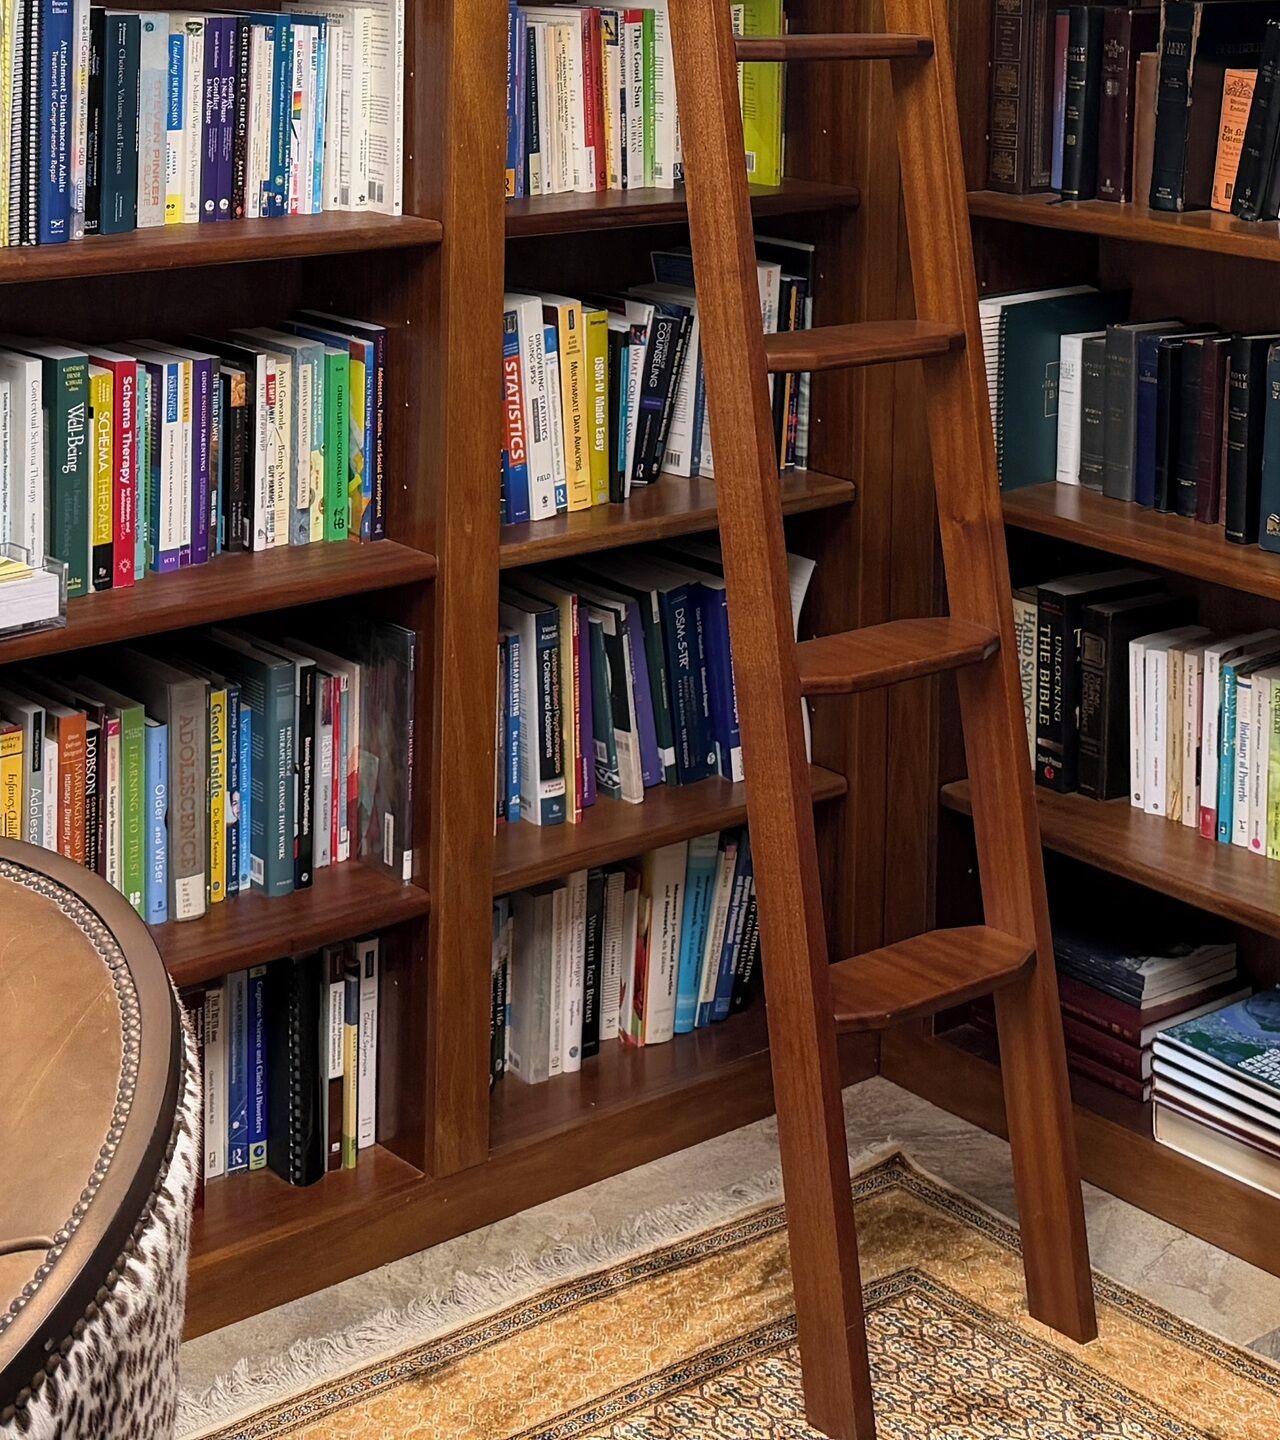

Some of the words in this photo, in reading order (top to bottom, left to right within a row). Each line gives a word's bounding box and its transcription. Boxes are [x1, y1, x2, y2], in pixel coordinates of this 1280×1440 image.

[634, 52, 642, 83] Good
[59, 94, 67, 150] Disturbances
[634, 86, 642, 108] Son
[59, 152, 66, 161] in
[535, 333, 545, 392] DISCOVERING
[121, 376, 132, 429] Schema
[505, 361, 524, 460] STATISTICS
[539, 395, 548, 441] STATISTICS
[595, 396, 605, 424] Made
[62, 402, 85, 474] Well-Being
[98, 411, 110, 474] SCHEMA
[120, 431, 132, 485] Therapy
[594, 427, 605, 451] Easy
[1040, 624, 1051, 664] THE
[1039, 668, 1050, 725] BIBLE
[1054, 636, 1062, 721] UNLOCKING
[211, 704, 222, 745] Good
[85, 736, 96, 796] DOBSON
[211, 749, 222, 799] Inside
[155, 784, 165, 820] Older
[180, 715, 196, 869] ADOLESCENCE
[155, 847, 165, 883] Wiser
